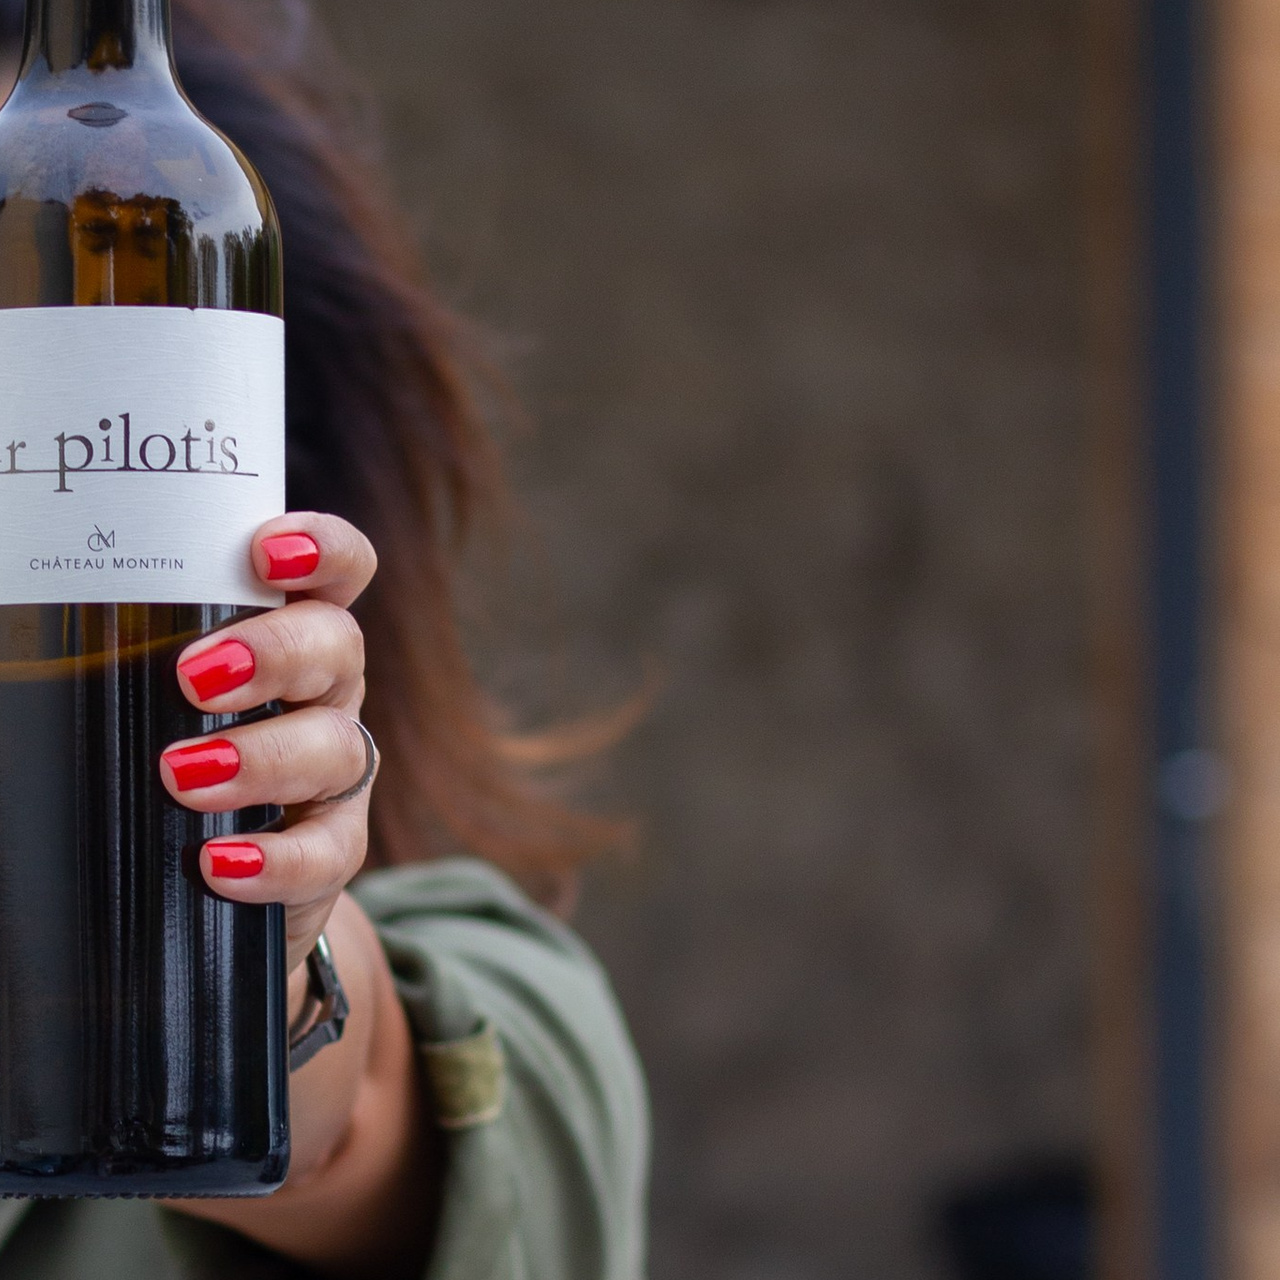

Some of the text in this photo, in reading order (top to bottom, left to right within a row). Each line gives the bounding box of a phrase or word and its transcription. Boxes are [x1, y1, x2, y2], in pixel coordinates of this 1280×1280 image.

[53, 412, 239, 493] pilotis
[29, 555, 185, 571] CHÂTEAU MONTFIN
